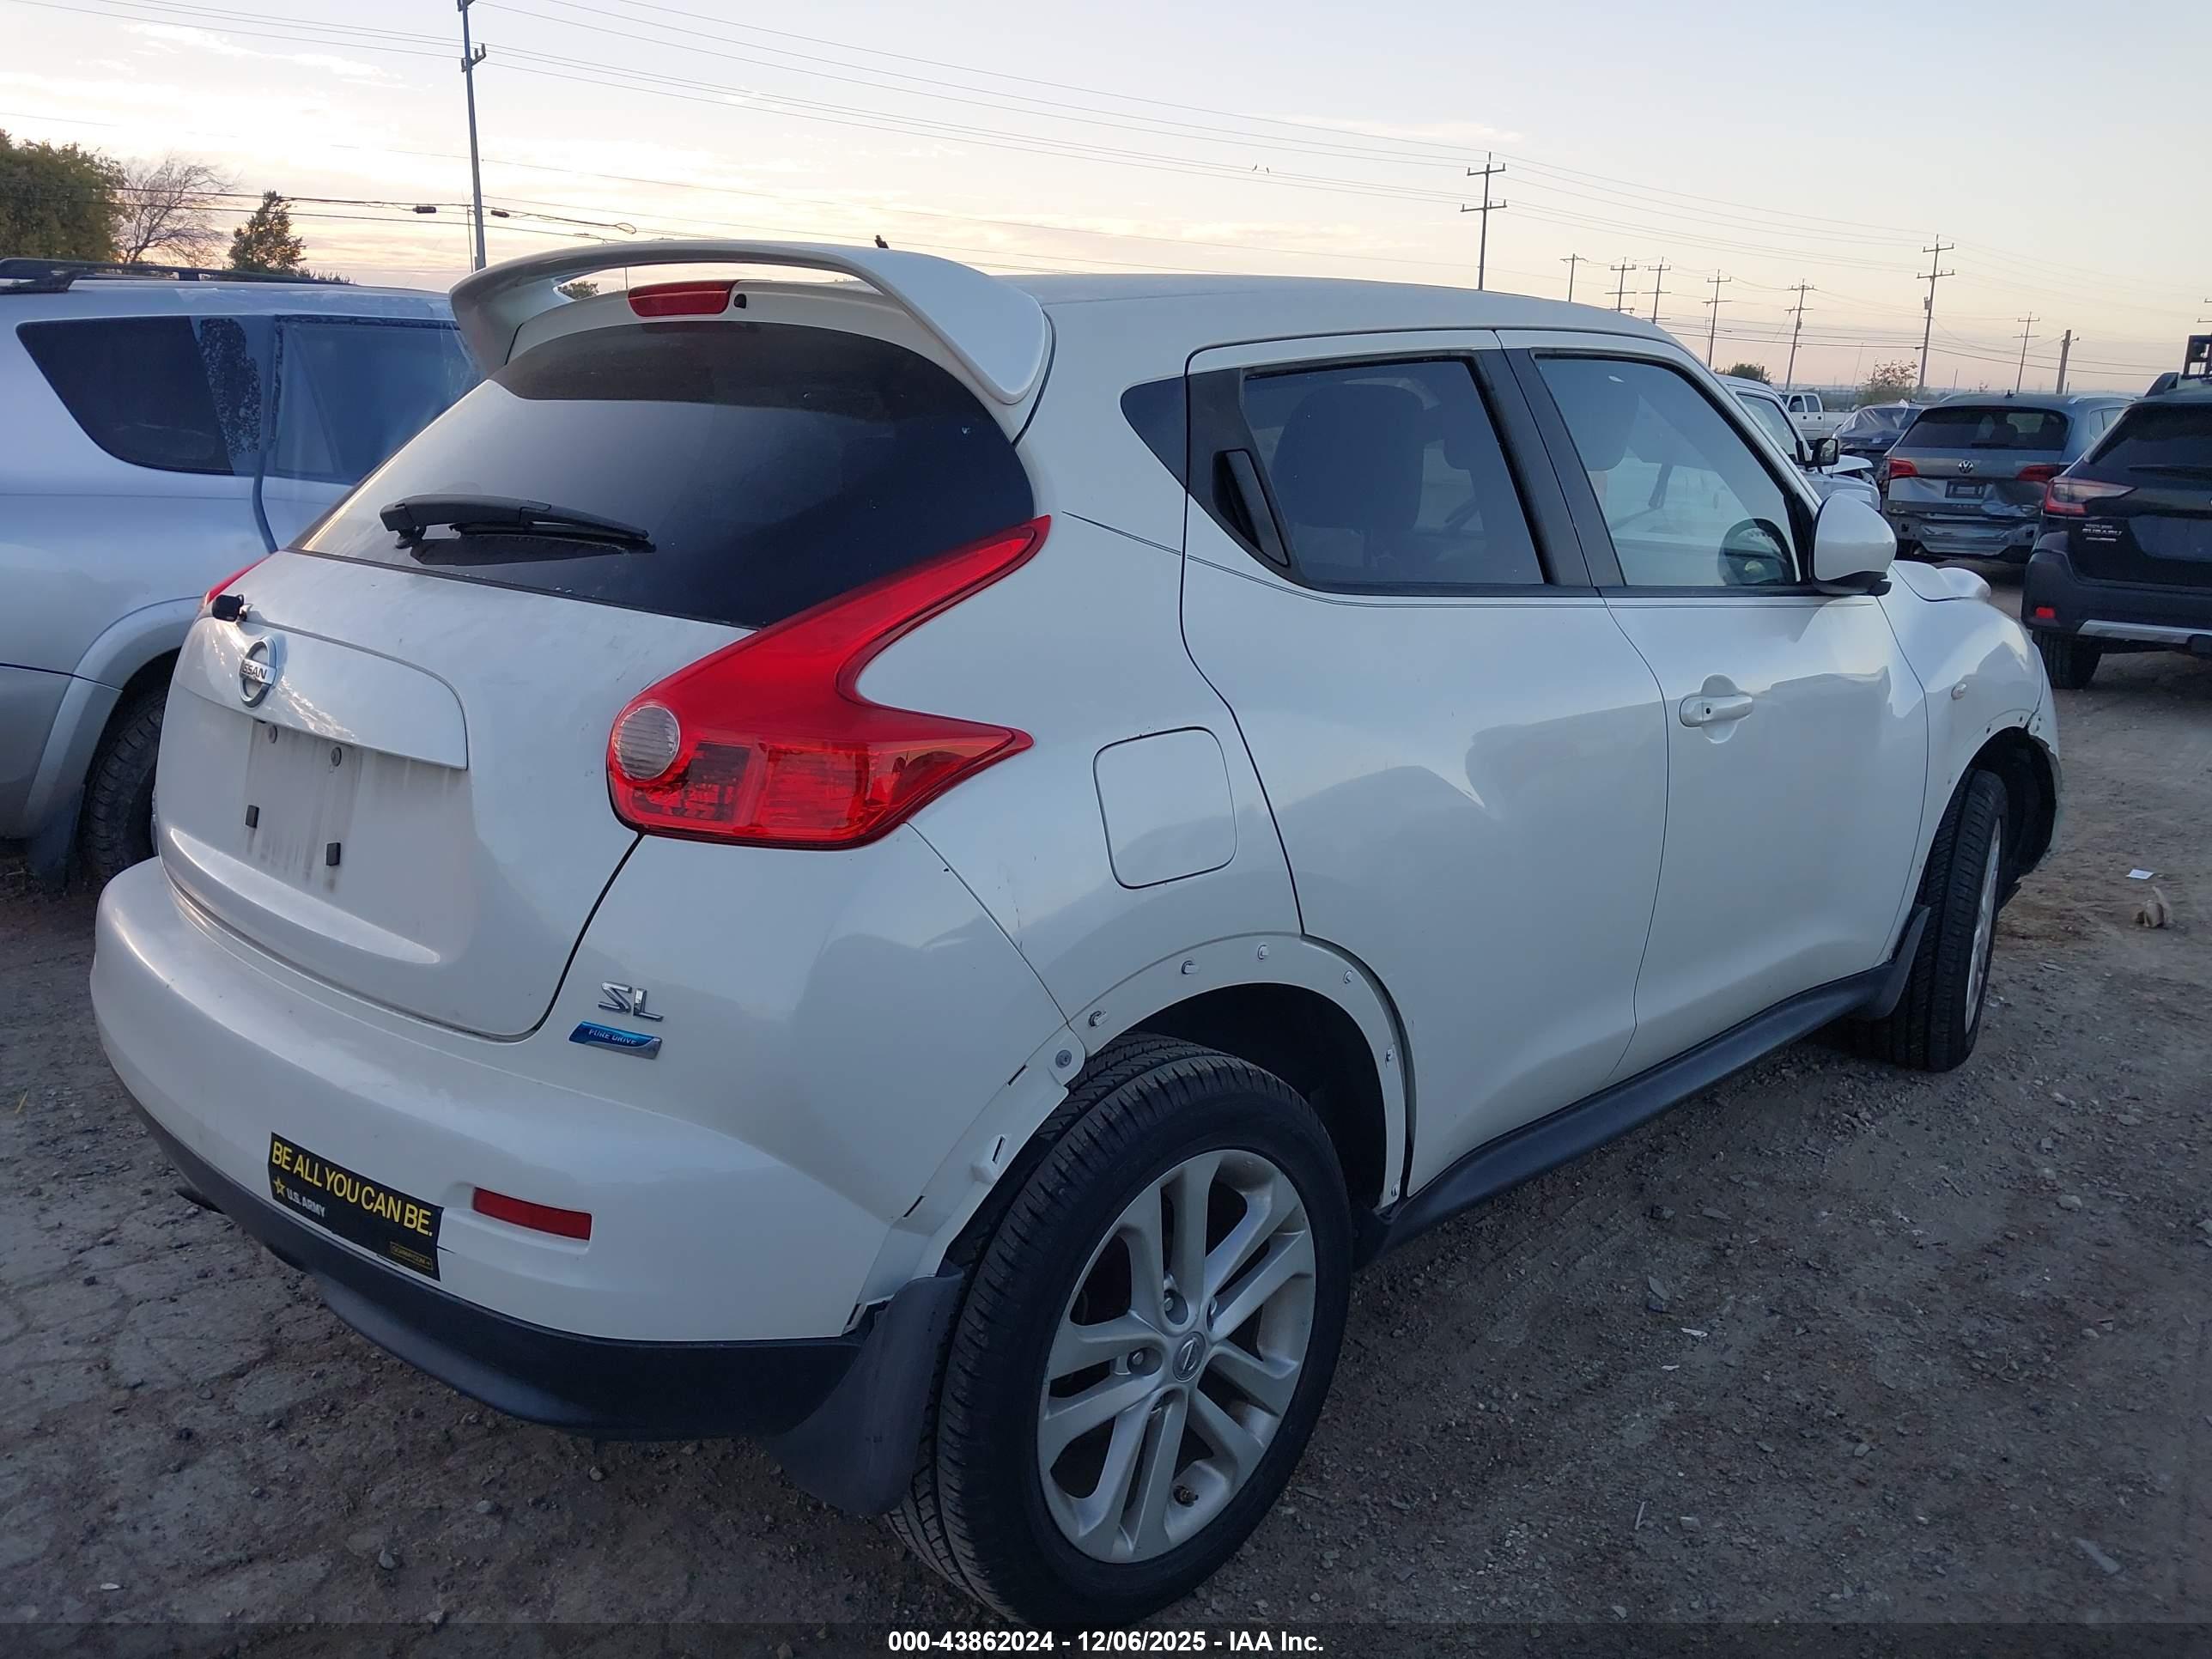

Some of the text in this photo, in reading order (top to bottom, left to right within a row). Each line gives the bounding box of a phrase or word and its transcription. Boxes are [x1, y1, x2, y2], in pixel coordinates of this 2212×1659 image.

[598, 981, 664, 1022] SL
[588, 1029, 636, 1045] PURE DRIVE
[271, 1140, 433, 1237] BE ALL YOU CAN BE.
[302, 1196, 325, 1218] ARMY
